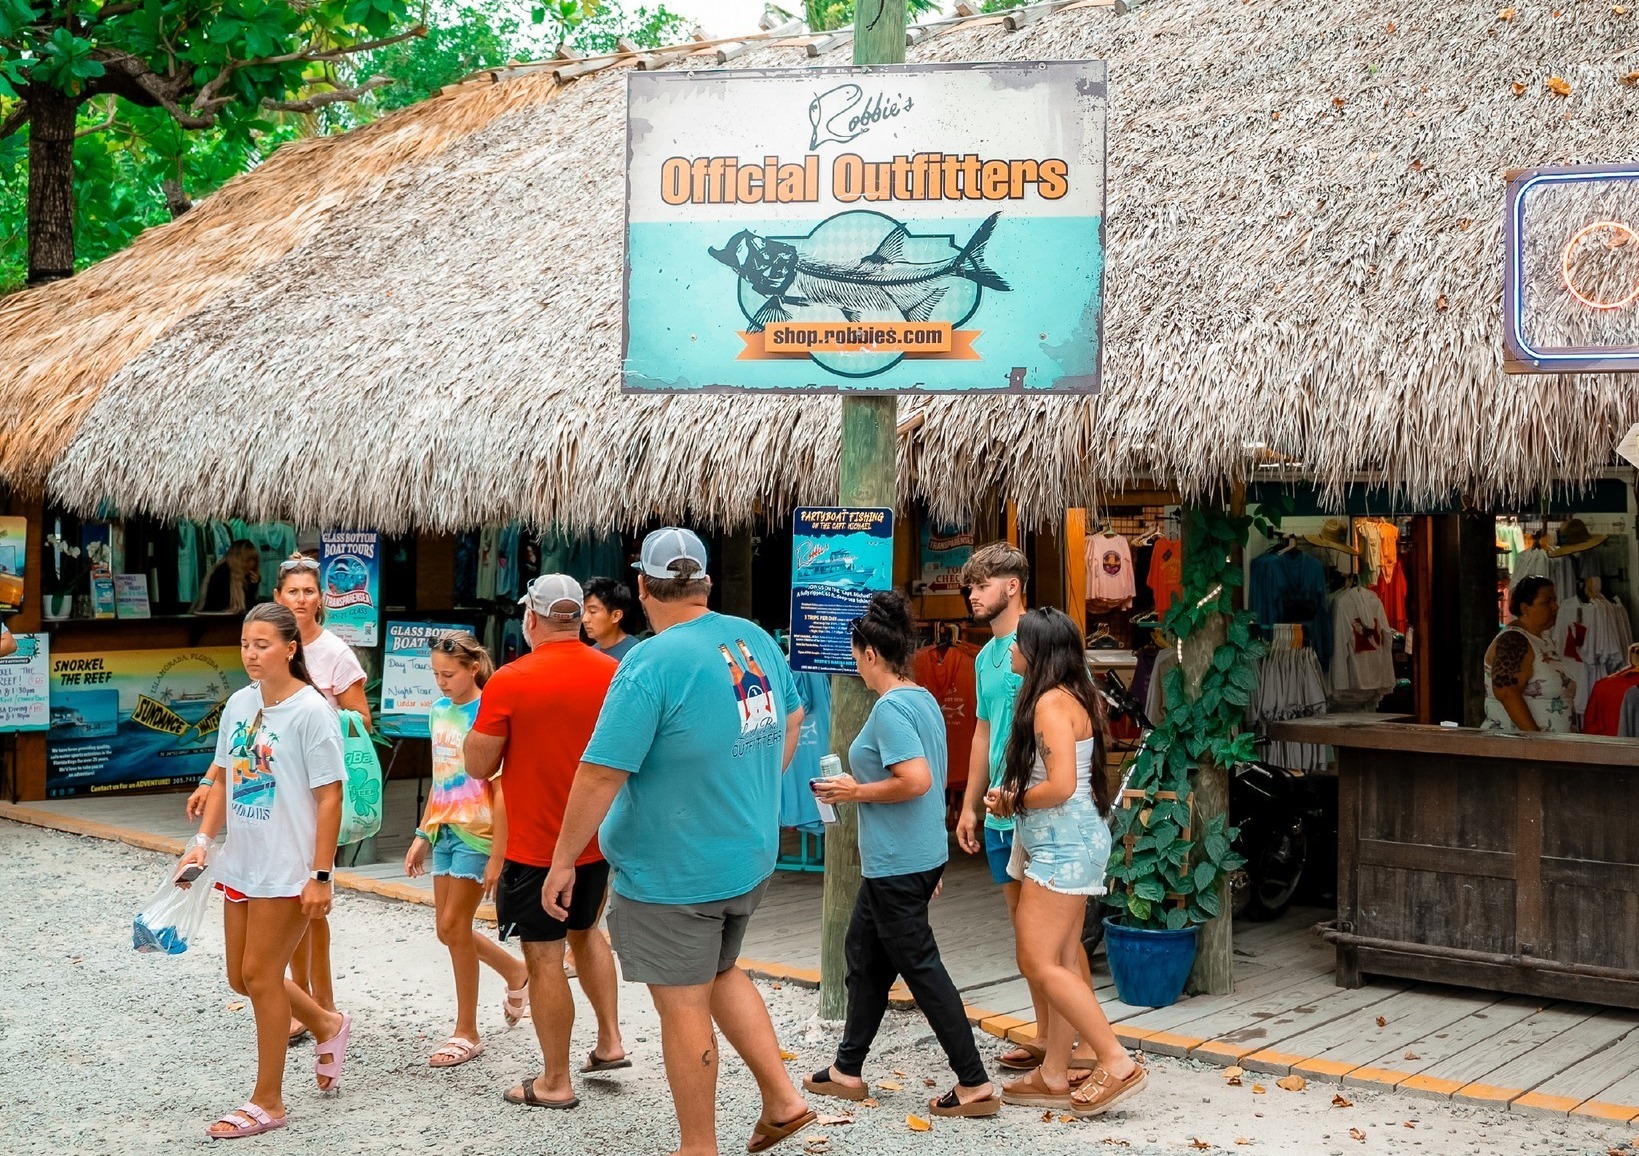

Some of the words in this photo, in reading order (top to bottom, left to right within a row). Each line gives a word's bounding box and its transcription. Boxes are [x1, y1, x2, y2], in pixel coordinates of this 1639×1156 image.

[809, 84, 914, 151] Robbie's
[661, 154, 820, 205] Official
[832, 152, 1068, 201] Outfitters
[773, 326, 942, 348] shop.robbies.com
[801, 511, 848, 522] PARTYBOAT
[849, 512, 884, 522] FISHING
[322, 533, 344, 542] GLASS
[345, 533, 377, 542] BOTTOM
[930, 536, 974, 550] TRANSPARENSE
[324, 544, 348, 558] BOAT
[348, 544, 374, 558] TOURS
[390, 626, 423, 637] GLASS
[393, 636, 426, 650] BOAT
[54, 658, 104, 672] SNORKEL
[388, 658, 406, 674] Day
[60, 673, 80, 686] THE
[84, 672, 112, 684] REEF
[388, 686, 412, 698] Night
[135, 698, 185, 733] SUNDANCE
[90, 784, 112, 792] Contact
[136, 778, 170, 788] ADVENTURE!
[172, 776, 205, 785] 305.743.0
